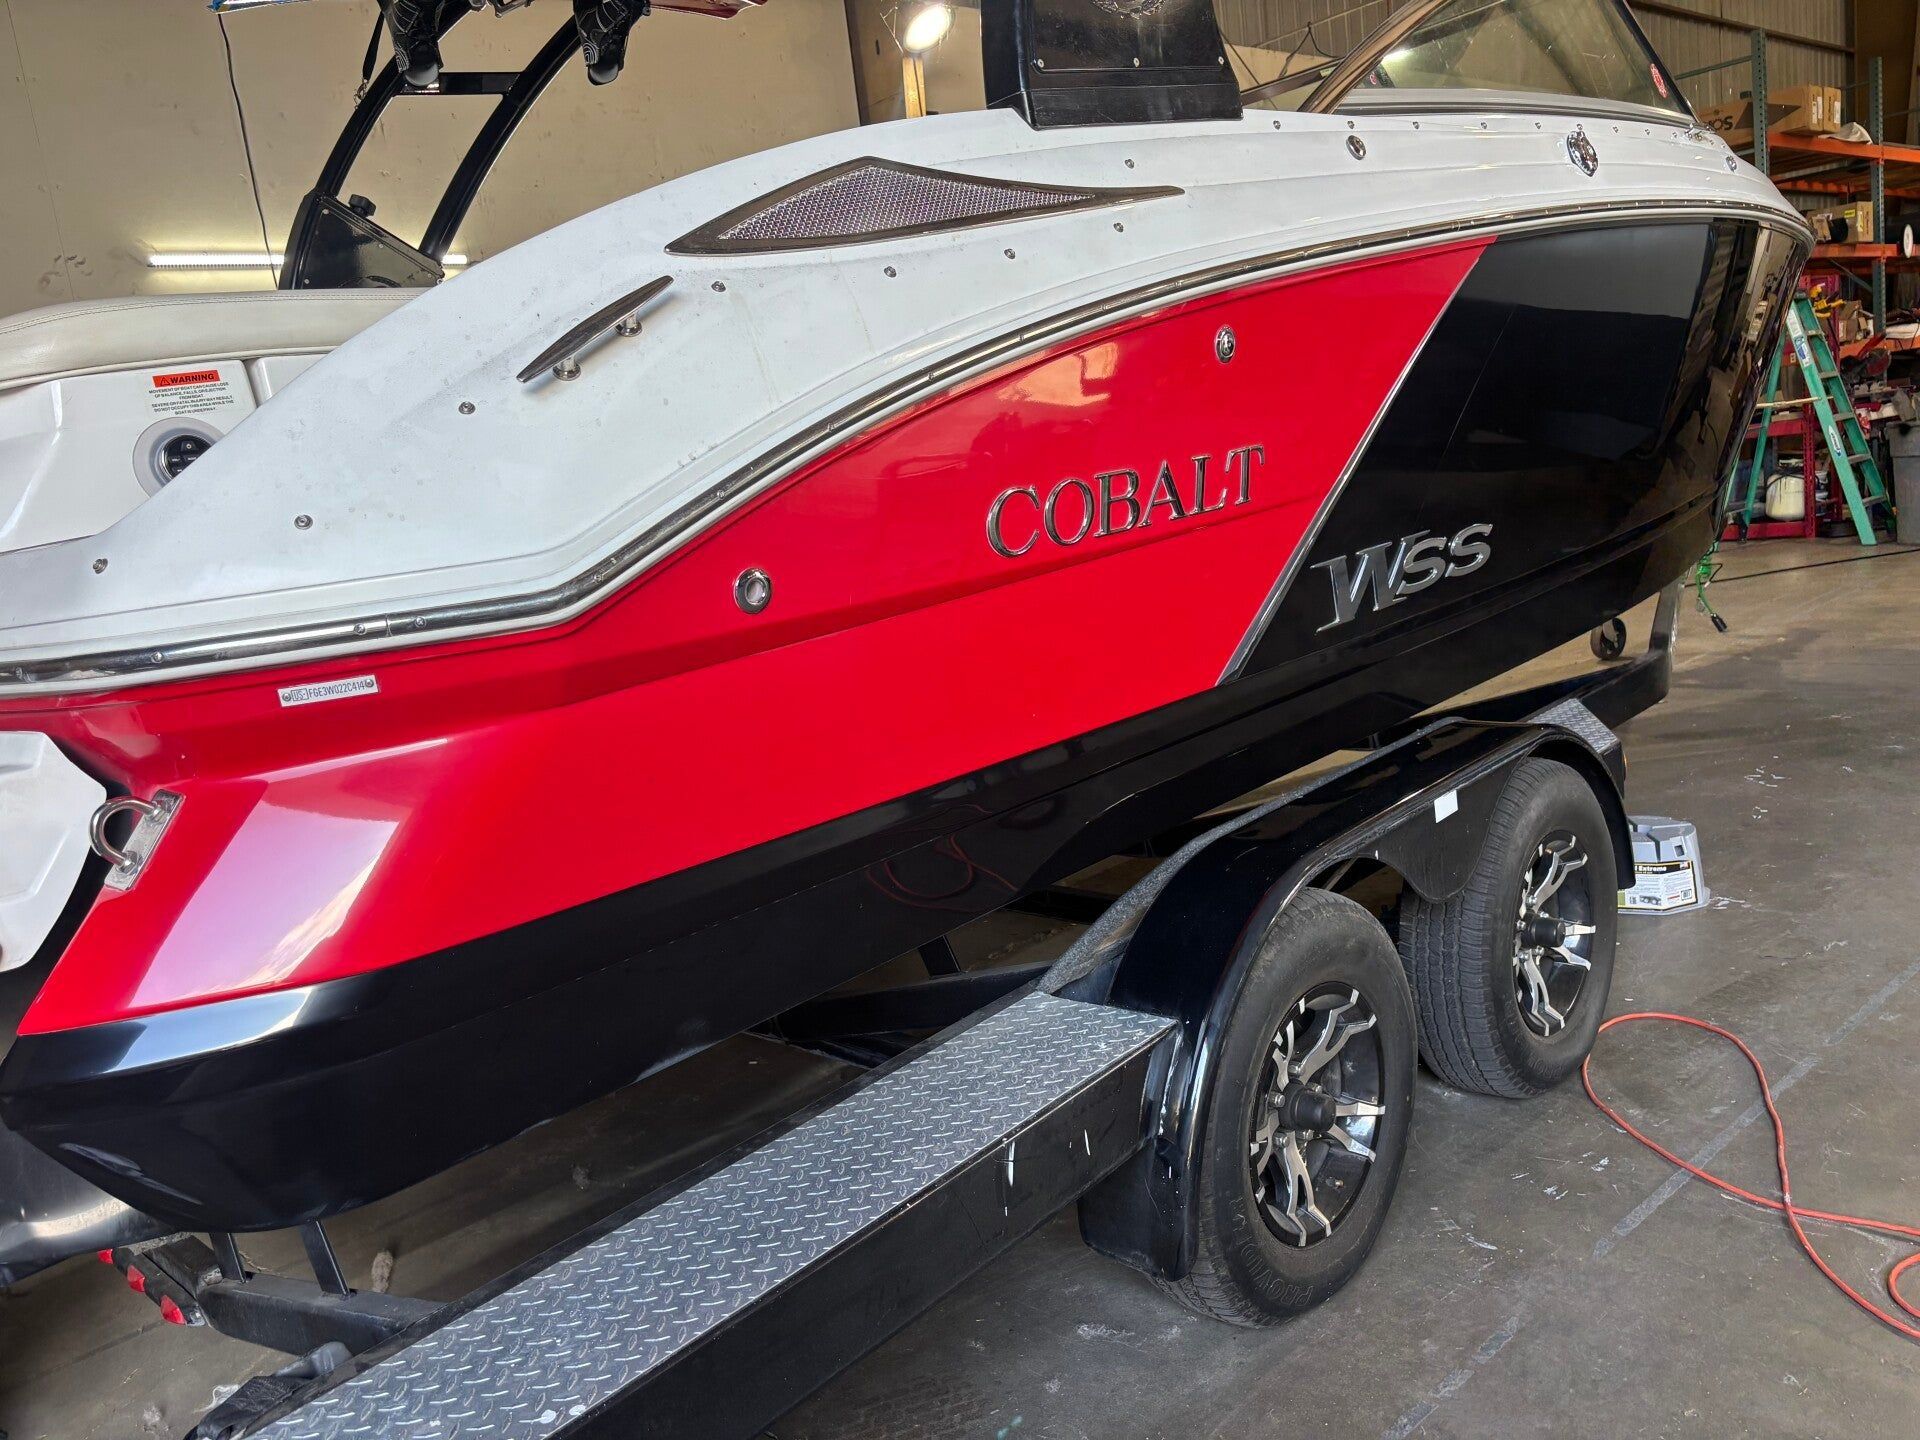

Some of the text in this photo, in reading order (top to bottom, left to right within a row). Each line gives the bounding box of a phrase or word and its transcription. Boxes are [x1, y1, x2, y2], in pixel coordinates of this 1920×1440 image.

[170, 373, 215, 384] WARNING
[986, 444, 1265, 557] COBALT
[1310, 523, 1494, 635] WSS
